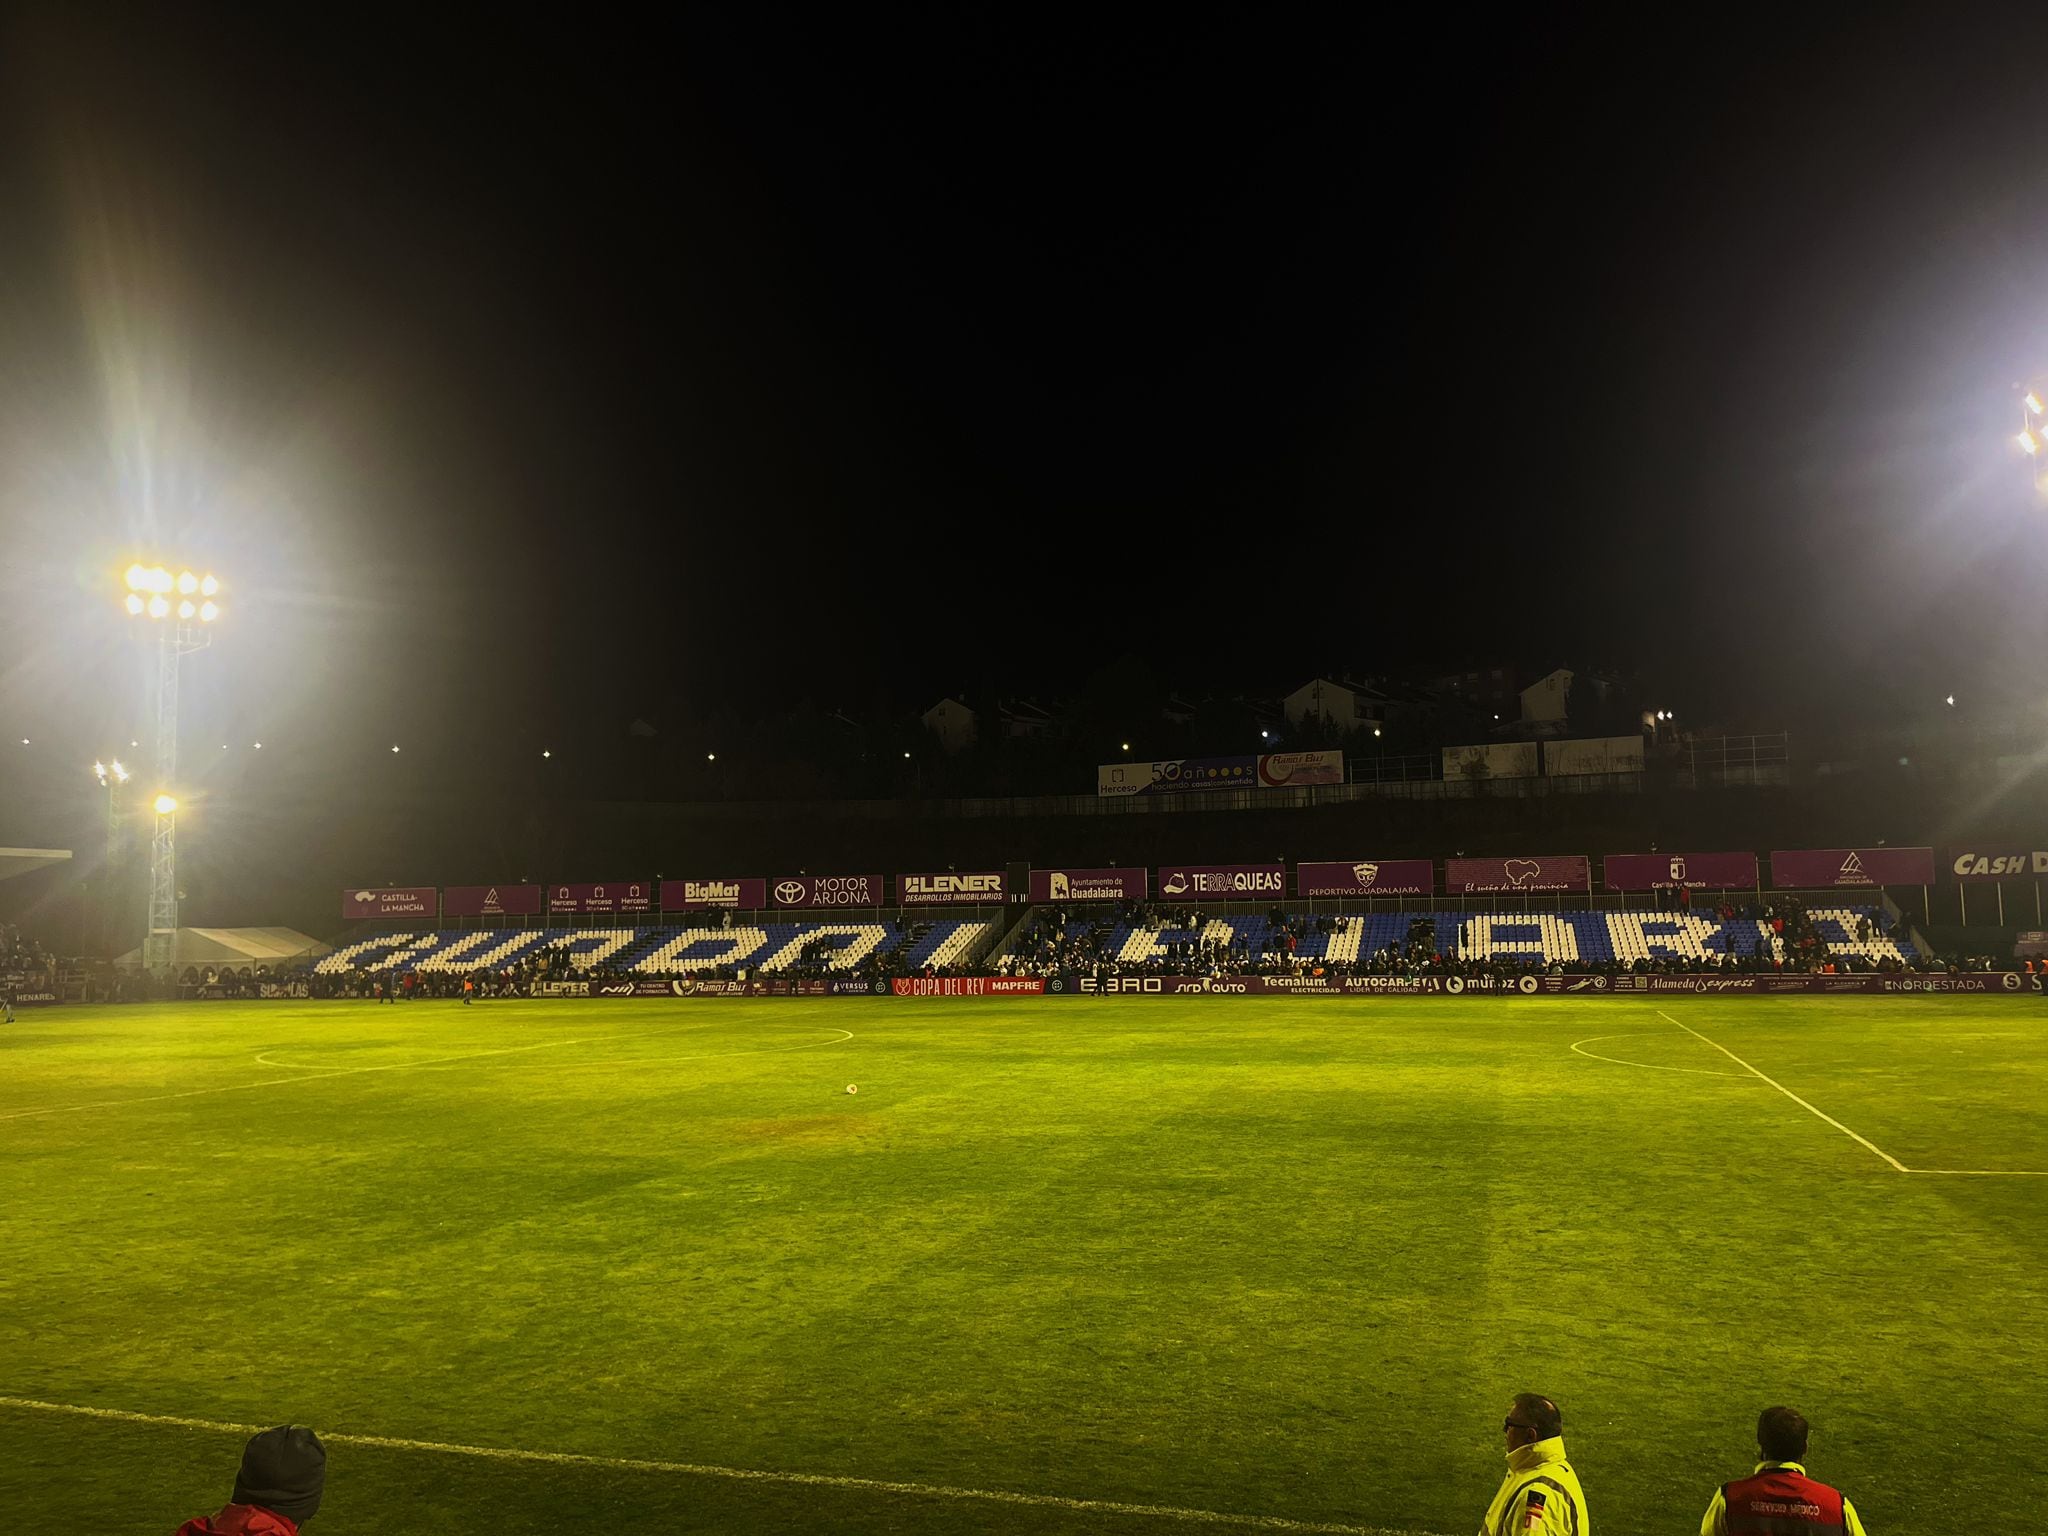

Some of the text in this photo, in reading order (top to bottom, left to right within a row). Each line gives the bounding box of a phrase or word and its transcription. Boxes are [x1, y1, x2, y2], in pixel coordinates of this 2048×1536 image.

[1100, 784, 1137, 793] Hercesa
[1151, 780, 1190, 792] haciendo
[1953, 853, 2027, 875] CASH
[815, 877, 868, 891] MOTOR
[1071, 877, 1123, 887] Ayuntamiento de
[1193, 872, 1282, 892] TERRAQUEAS
[1465, 883, 1474, 892] El
[1500, 882, 1510, 891] de
[685, 882, 740, 902] BigMat
[1071, 887, 1123, 898] Guadalajara
[1309, 886, 1420, 896] DEPORTIVO GUADALAJARA
[812, 891, 871, 904] ARJONA
[905, 892, 1003, 902] DESARROLLOS INMOBILIARIOS
[381, 903, 425, 912] LA MANCHA
[695, 981, 727, 992] Ramos
[727, 981, 747, 992] Bus
[839, 982, 869, 990] VERSUS
[913, 977, 985, 996] COPA DEL REY
[992, 981, 1040, 991] MAPFRE
[1262, 976, 1327, 987] Tecnalum
[1650, 978, 1695, 989] Alameda
[1707, 979, 1756, 991] express
[1892, 980, 1986, 991] NORDESTADA
